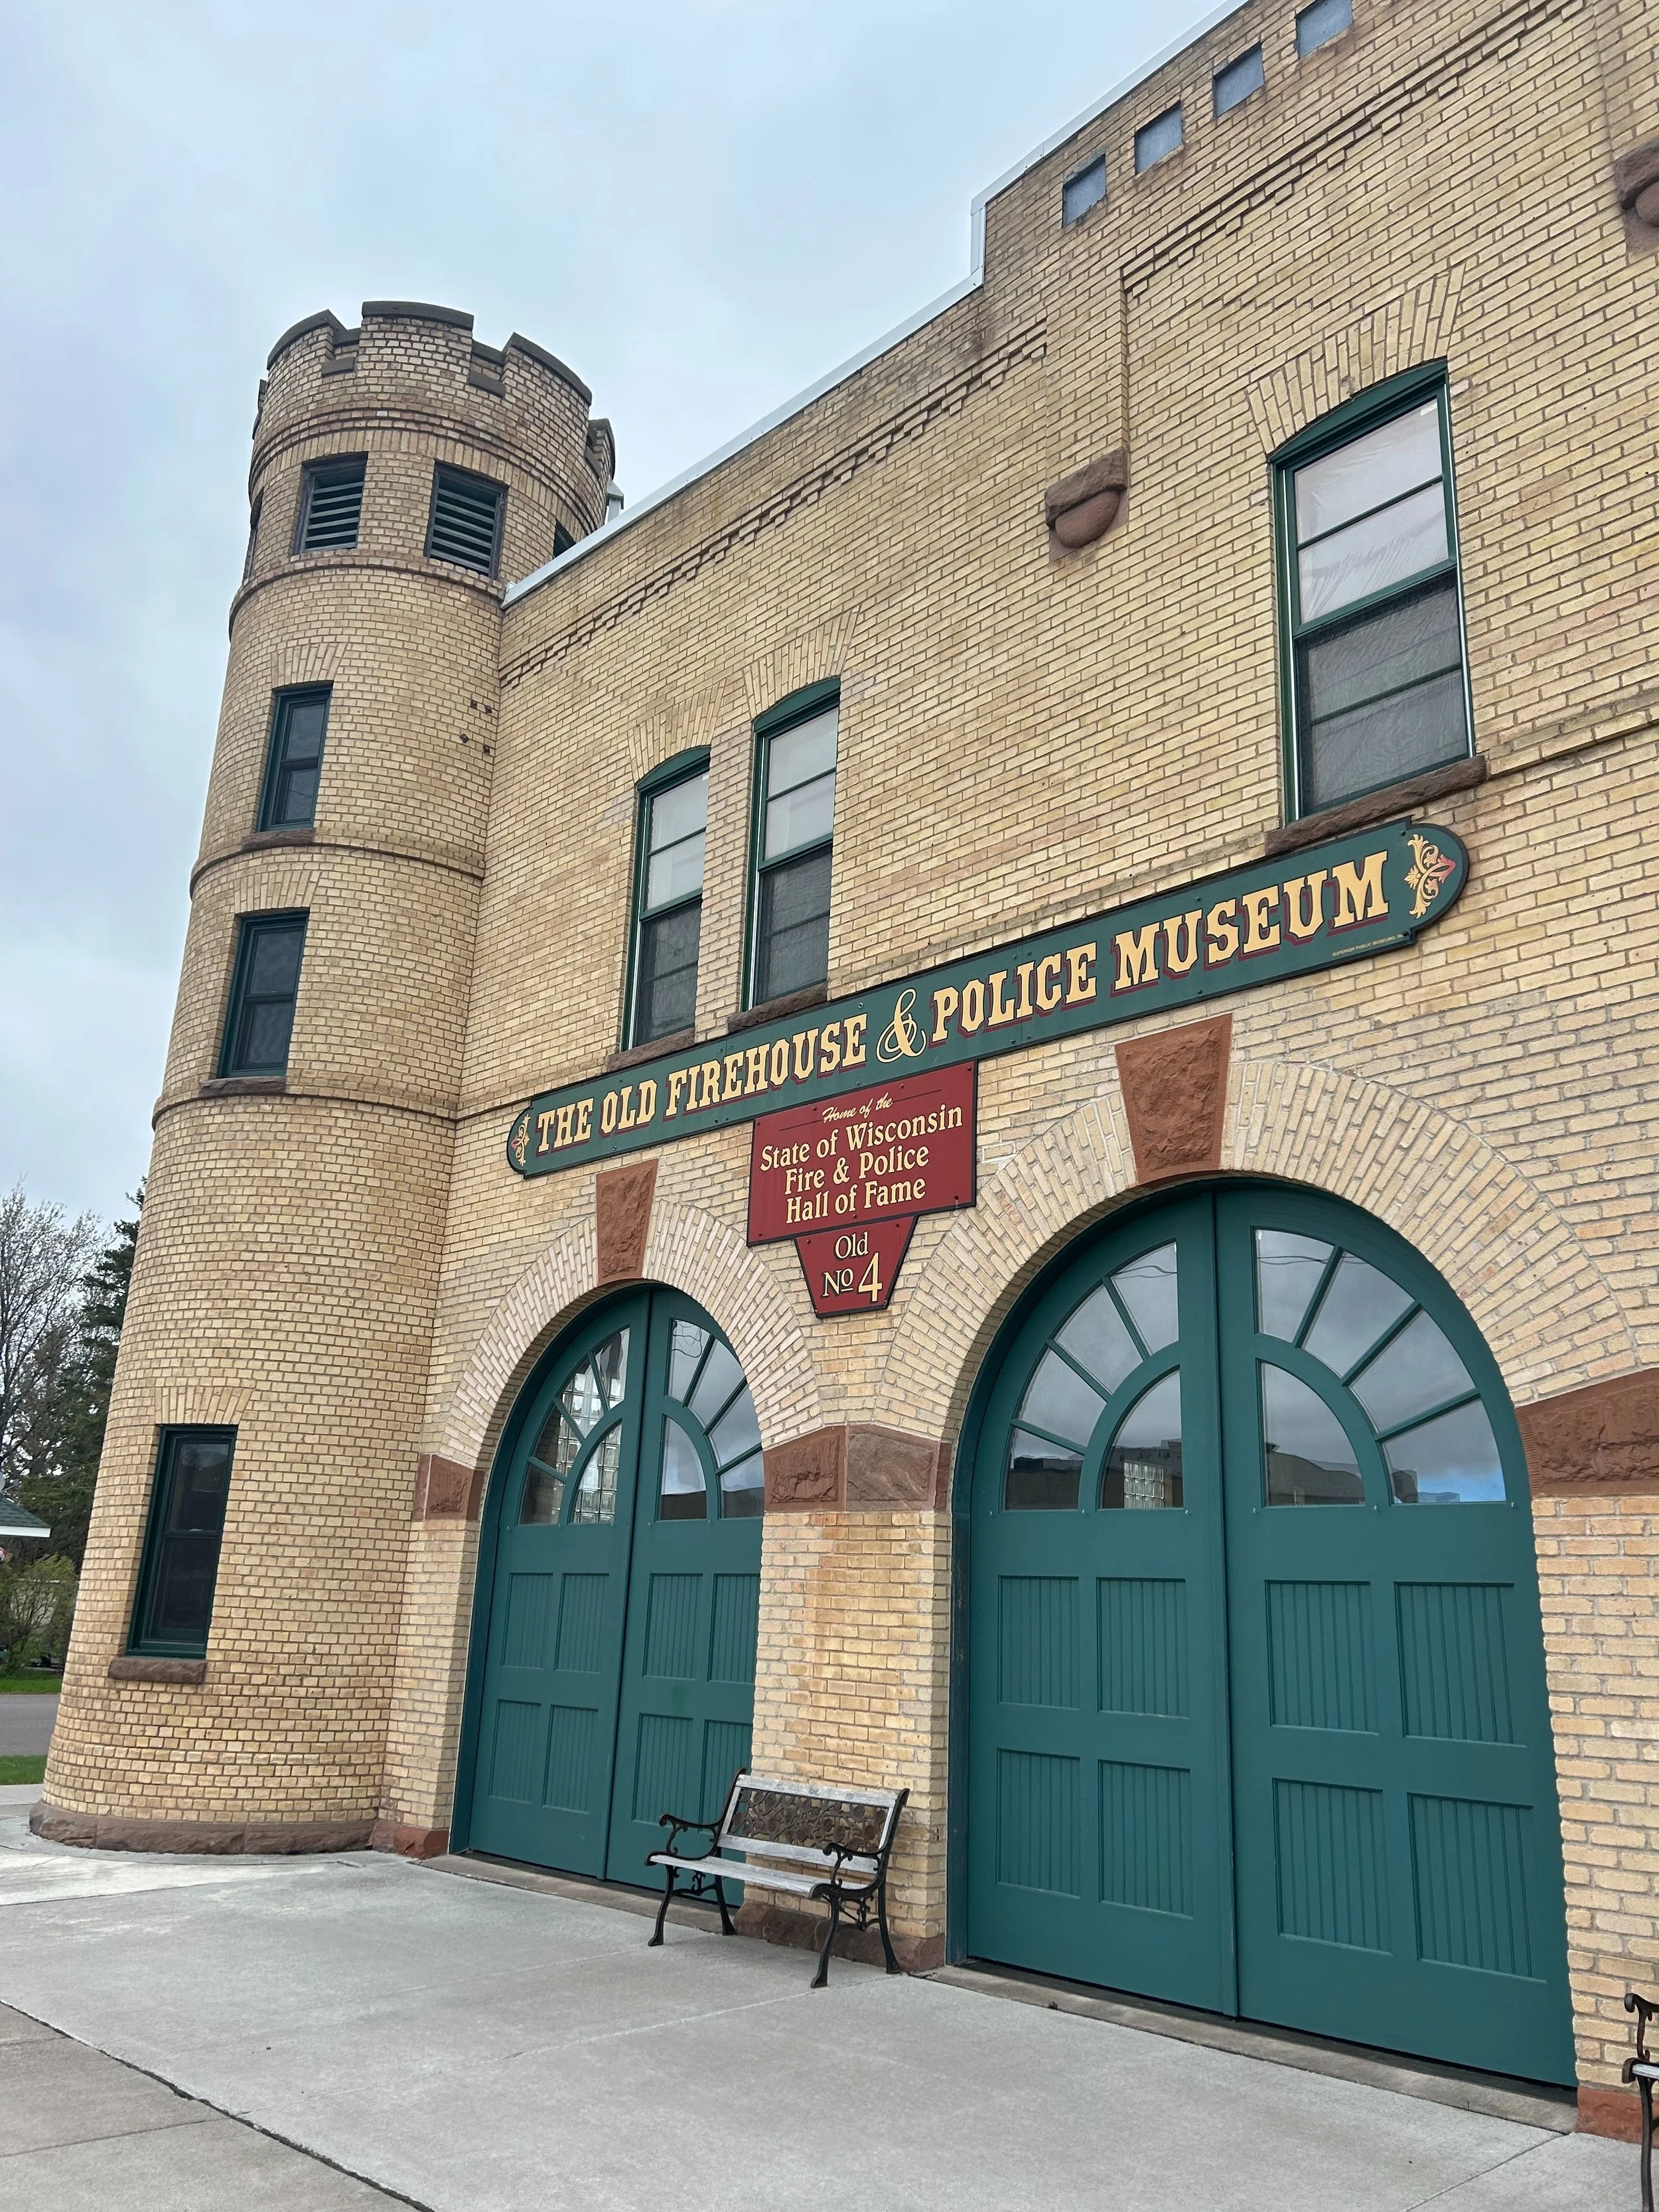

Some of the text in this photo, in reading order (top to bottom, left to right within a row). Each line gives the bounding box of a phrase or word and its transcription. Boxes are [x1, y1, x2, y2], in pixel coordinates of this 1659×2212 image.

[1332, 946, 1355, 956] SUPERIOR
[538, 850, 1389, 1153] THE OLD FIREHOUSE & POLICE MUSEUM
[822, 1092, 894, 1124] Home of the
[760, 1103, 963, 1171] State of Wisconsin
[784, 1145, 930, 1195] Fire & Police
[786, 1177, 926, 1224] Hall of Fame
[834, 1230, 869, 1260] Old
[858, 1252, 883, 1302] 4
